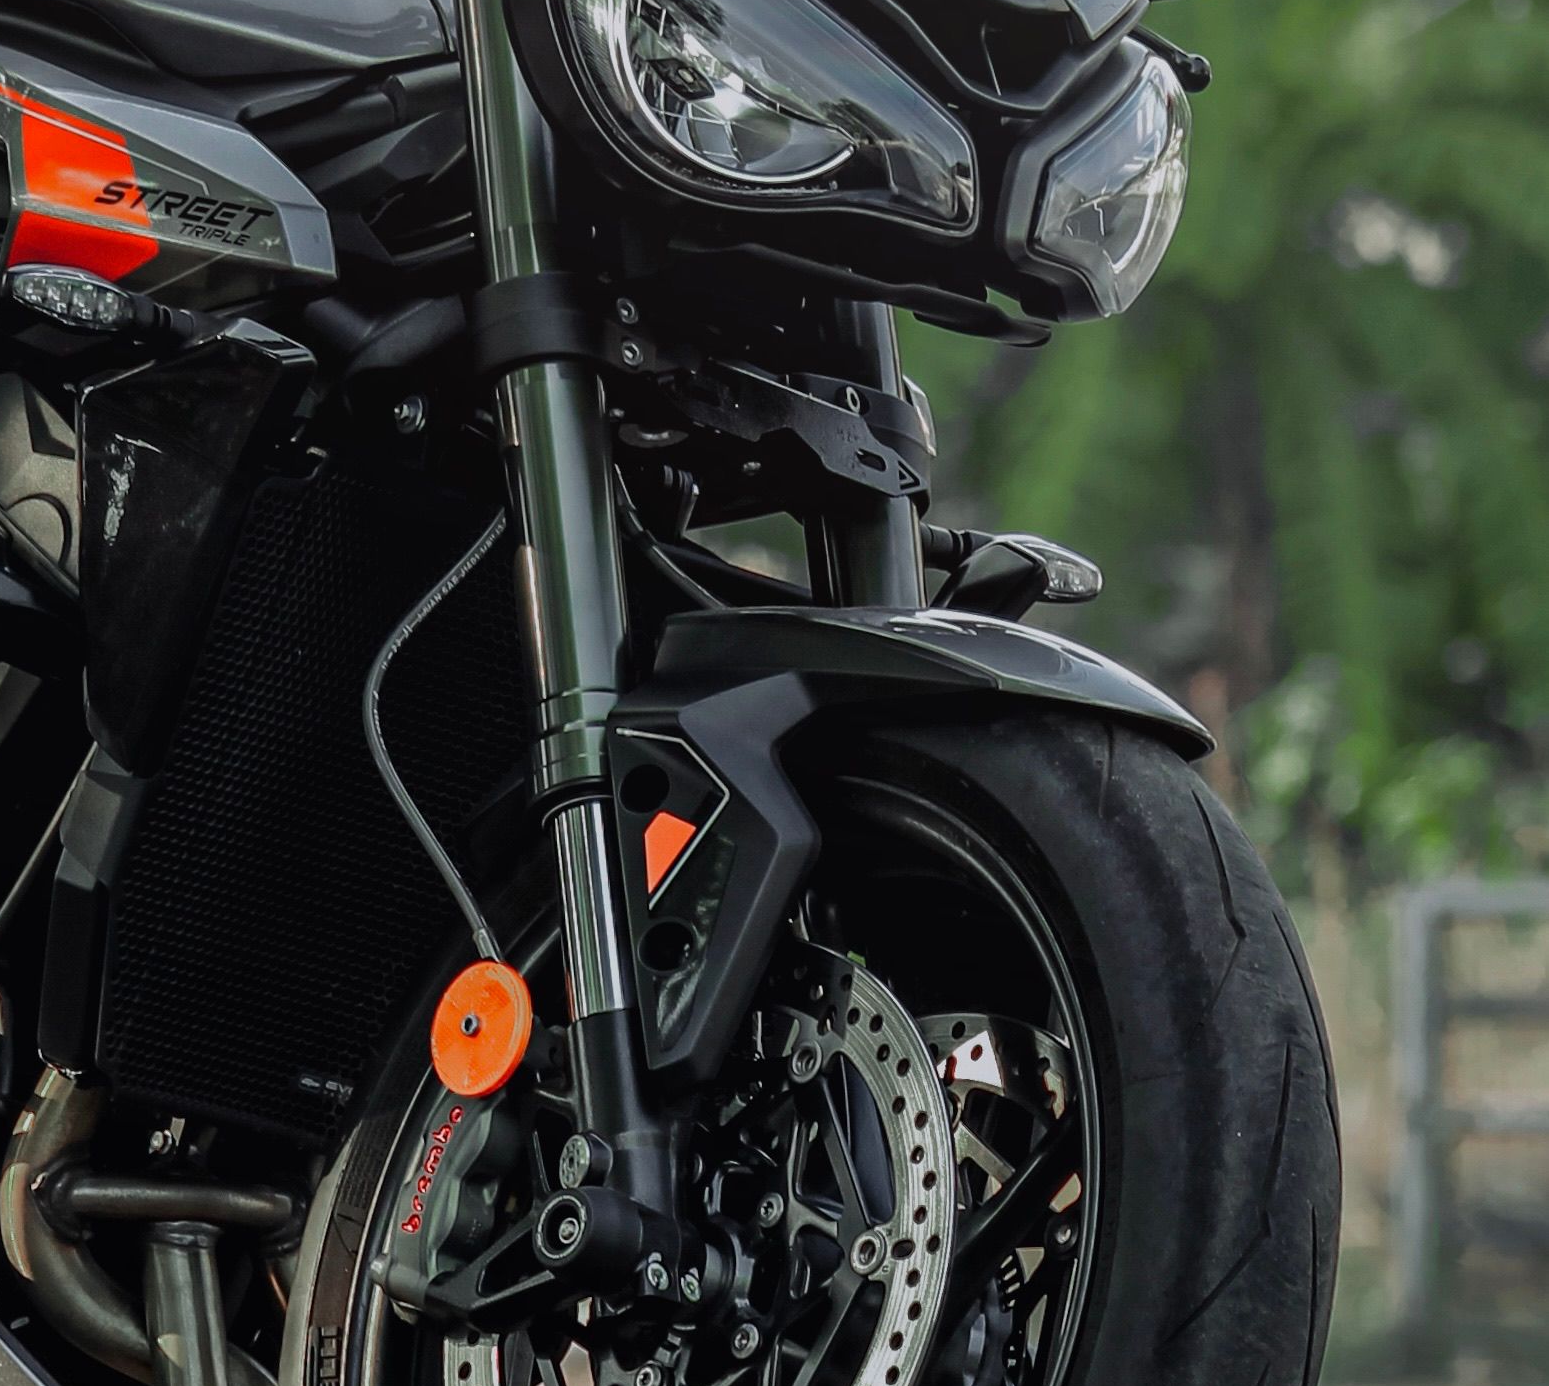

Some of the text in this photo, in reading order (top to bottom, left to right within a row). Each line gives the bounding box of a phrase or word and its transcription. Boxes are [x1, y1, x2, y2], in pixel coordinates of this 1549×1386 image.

[94, 181, 274, 231] STREET
[179, 222, 250, 247] TRIPLE
[401, 1105, 463, 1232] brembo
